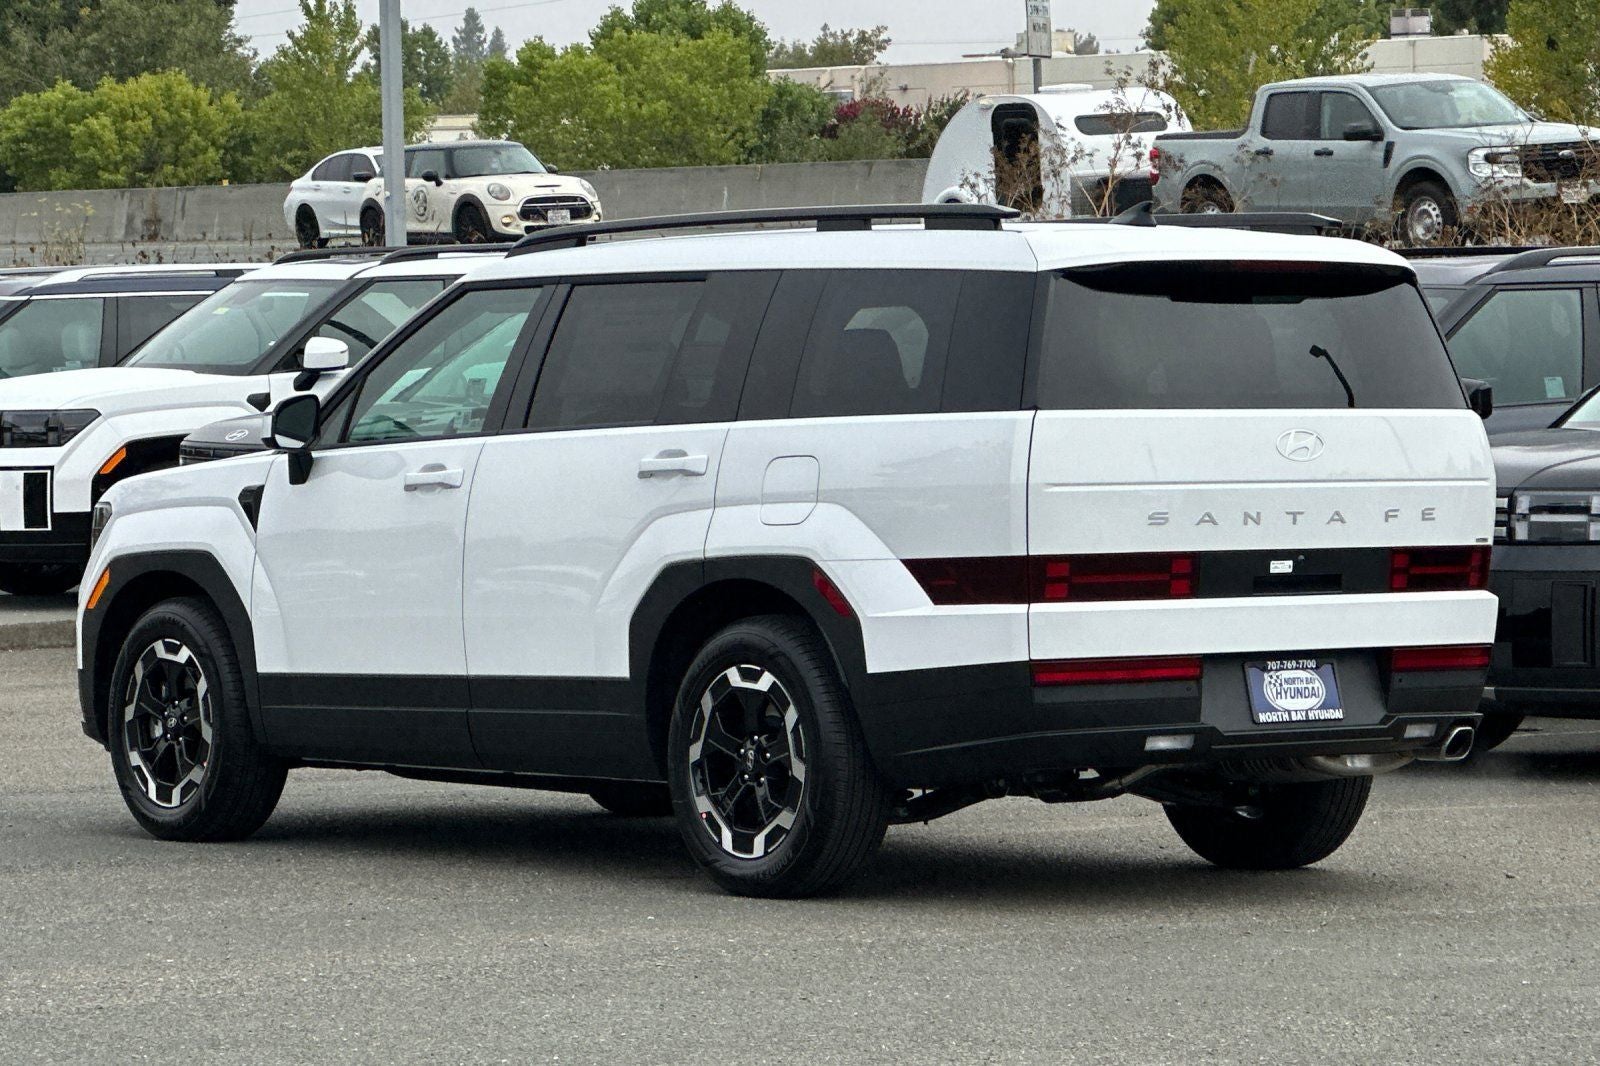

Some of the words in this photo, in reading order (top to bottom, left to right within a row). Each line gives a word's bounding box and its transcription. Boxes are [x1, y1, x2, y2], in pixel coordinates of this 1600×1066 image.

[1147, 510, 1347, 526] SANTA
[1384, 507, 1437, 523] FE
[1266, 660, 1317, 670] 707-769-7700
[1283, 676, 1304, 686] NORTH
[1305, 676, 1317, 685] BAY
[1276, 686, 1320, 700] HYUNDAI
[1258, 711, 1290, 722] NORTH
[1291, 710, 1307, 721] BAY
[1308, 708, 1344, 720] HYUNDAI
